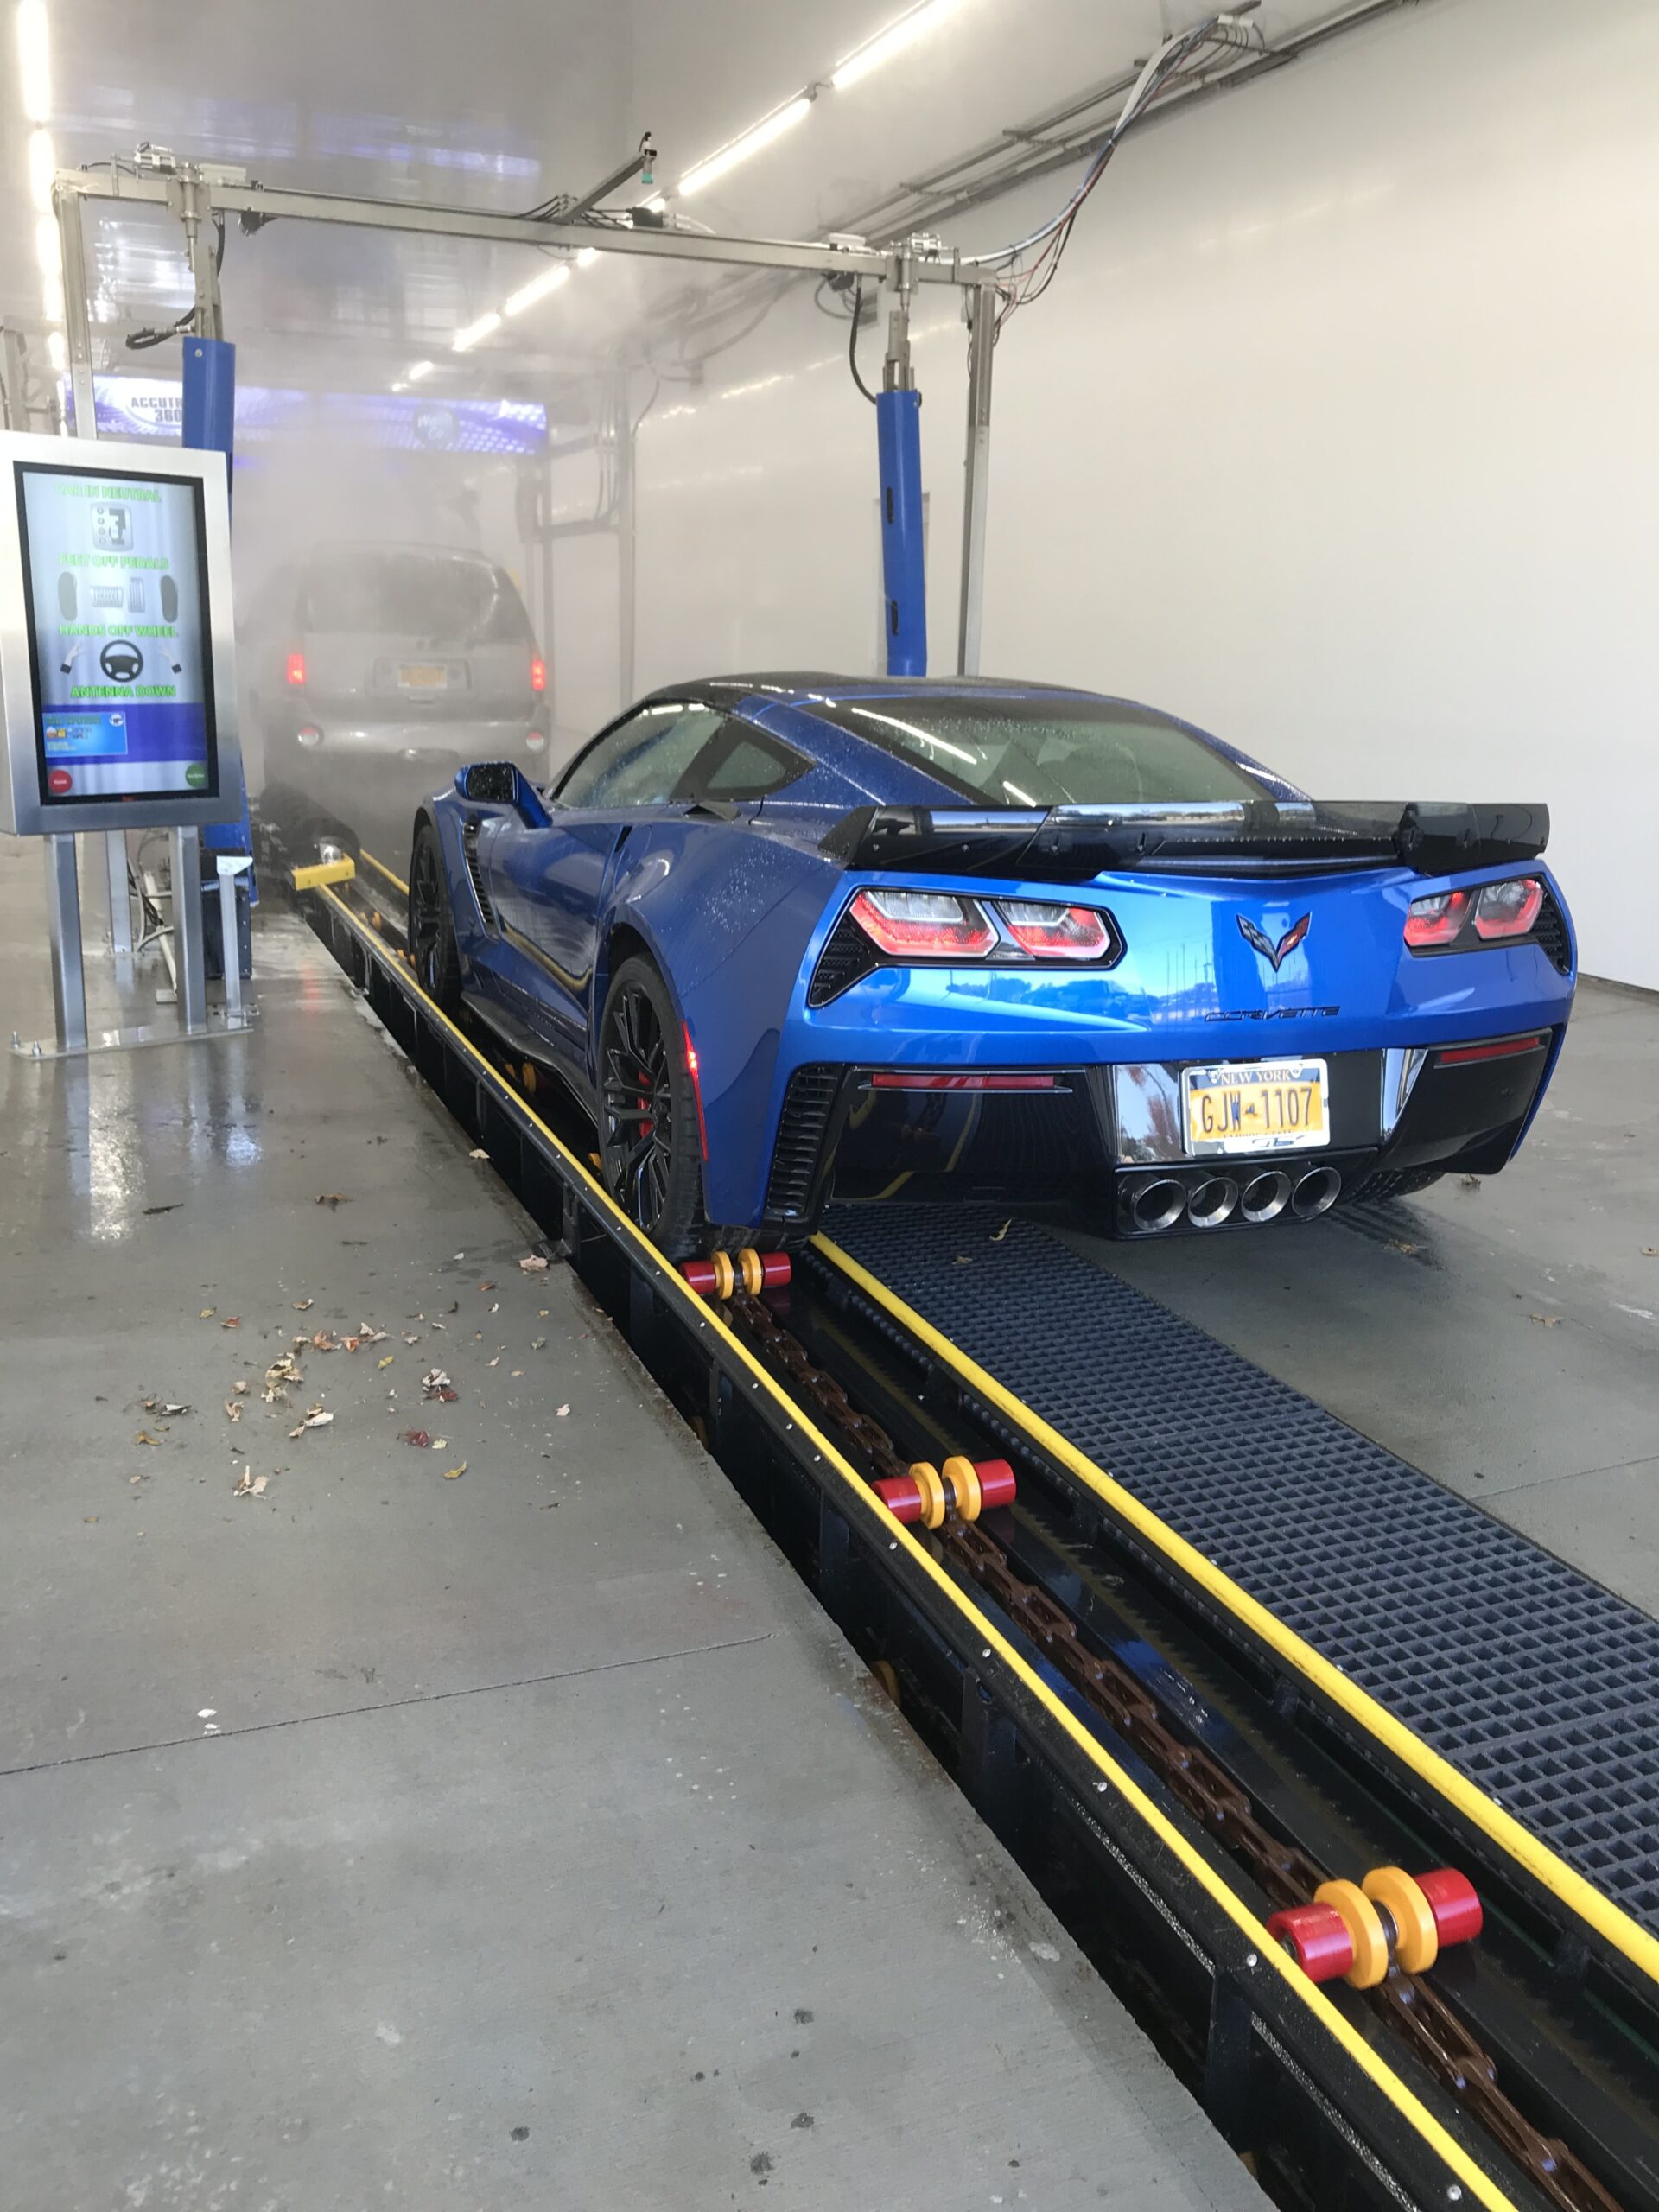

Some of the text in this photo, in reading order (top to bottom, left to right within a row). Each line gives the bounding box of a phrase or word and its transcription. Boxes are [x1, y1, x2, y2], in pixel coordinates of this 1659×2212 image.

[131, 397, 182, 409] ACCUTR
[54, 483, 162, 502] CAR IN NEUTRAL
[57, 553, 169, 570] FEET OFF PEDALS
[59, 624, 178, 638] HANDS OFF WHEEL
[70, 684, 176, 698] ANTENNA DOWN
[1205, 1006, 1341, 1022] CORVETTE
[1221, 1068, 1292, 1085] NEW YORK
